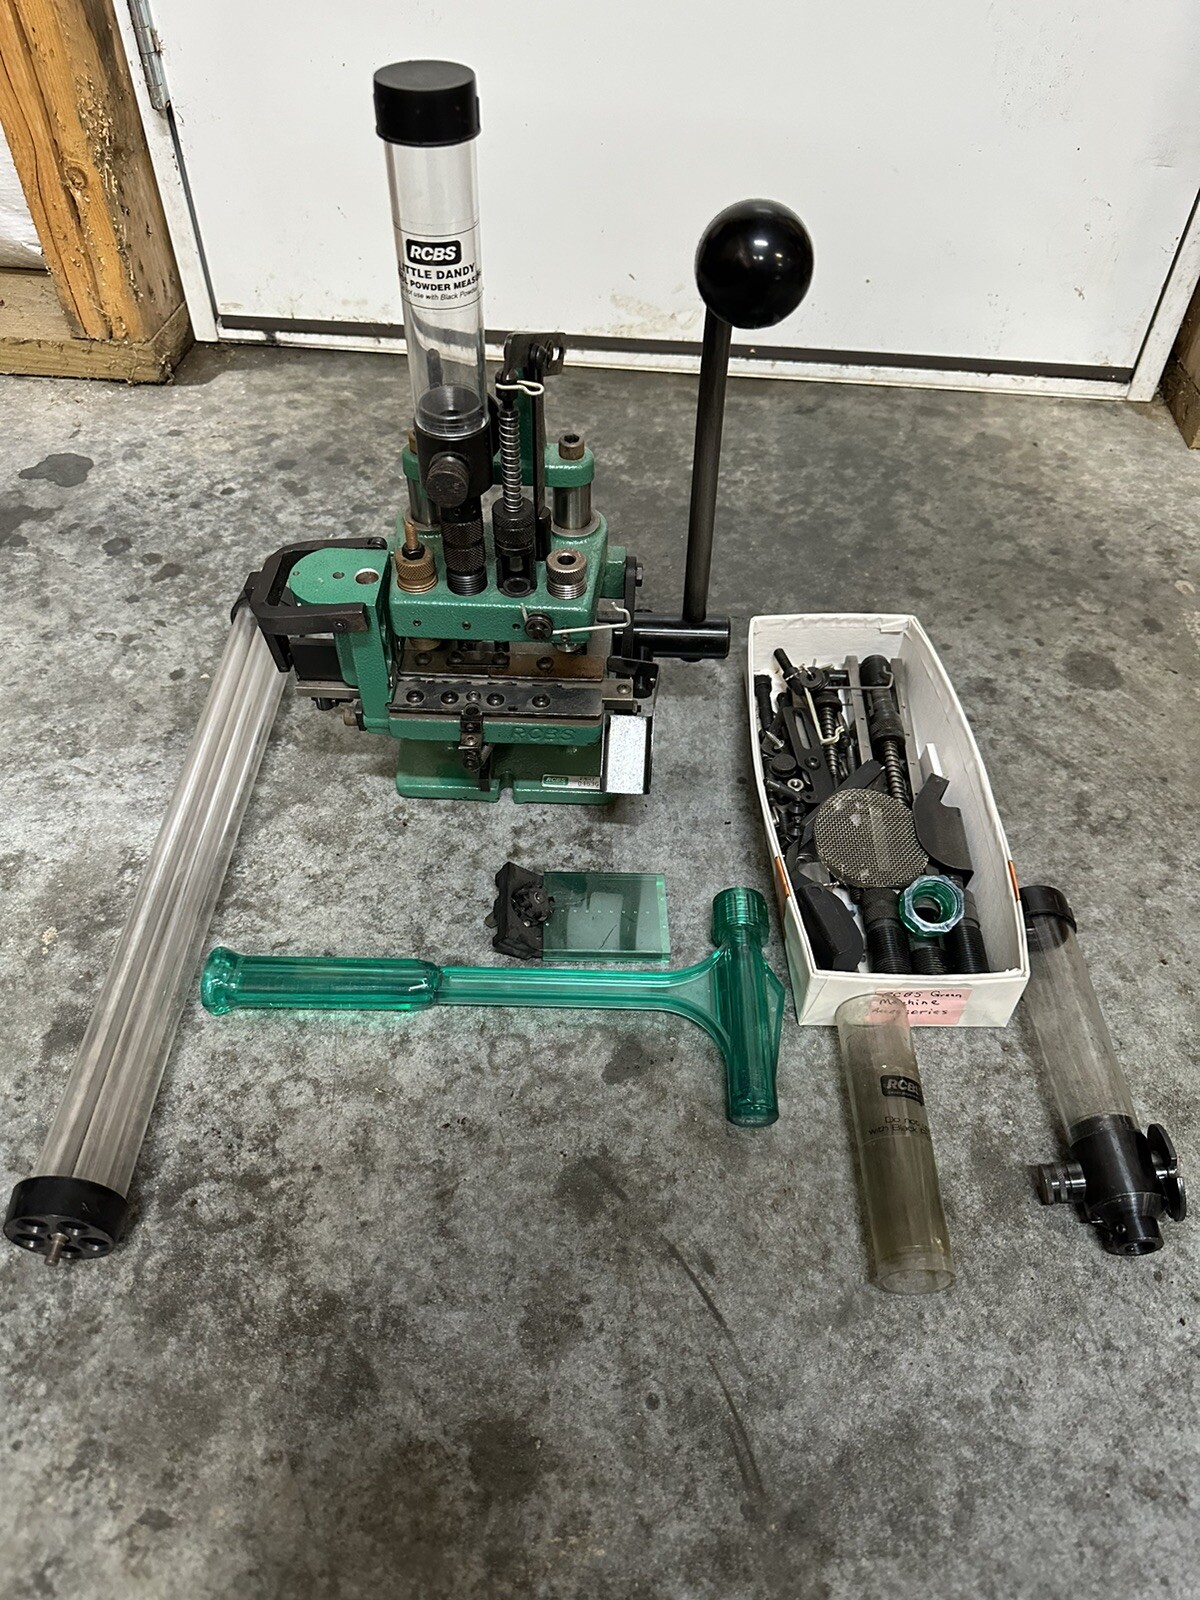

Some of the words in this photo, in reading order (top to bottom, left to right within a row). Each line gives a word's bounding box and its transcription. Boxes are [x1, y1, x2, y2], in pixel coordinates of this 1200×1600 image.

[409, 244, 457, 261] RCBS
[436, 262, 475, 280] DANDY
[410, 279, 451, 292] POWDER
[440, 292, 458, 301] Black
[510, 726, 577, 741] RCBS
